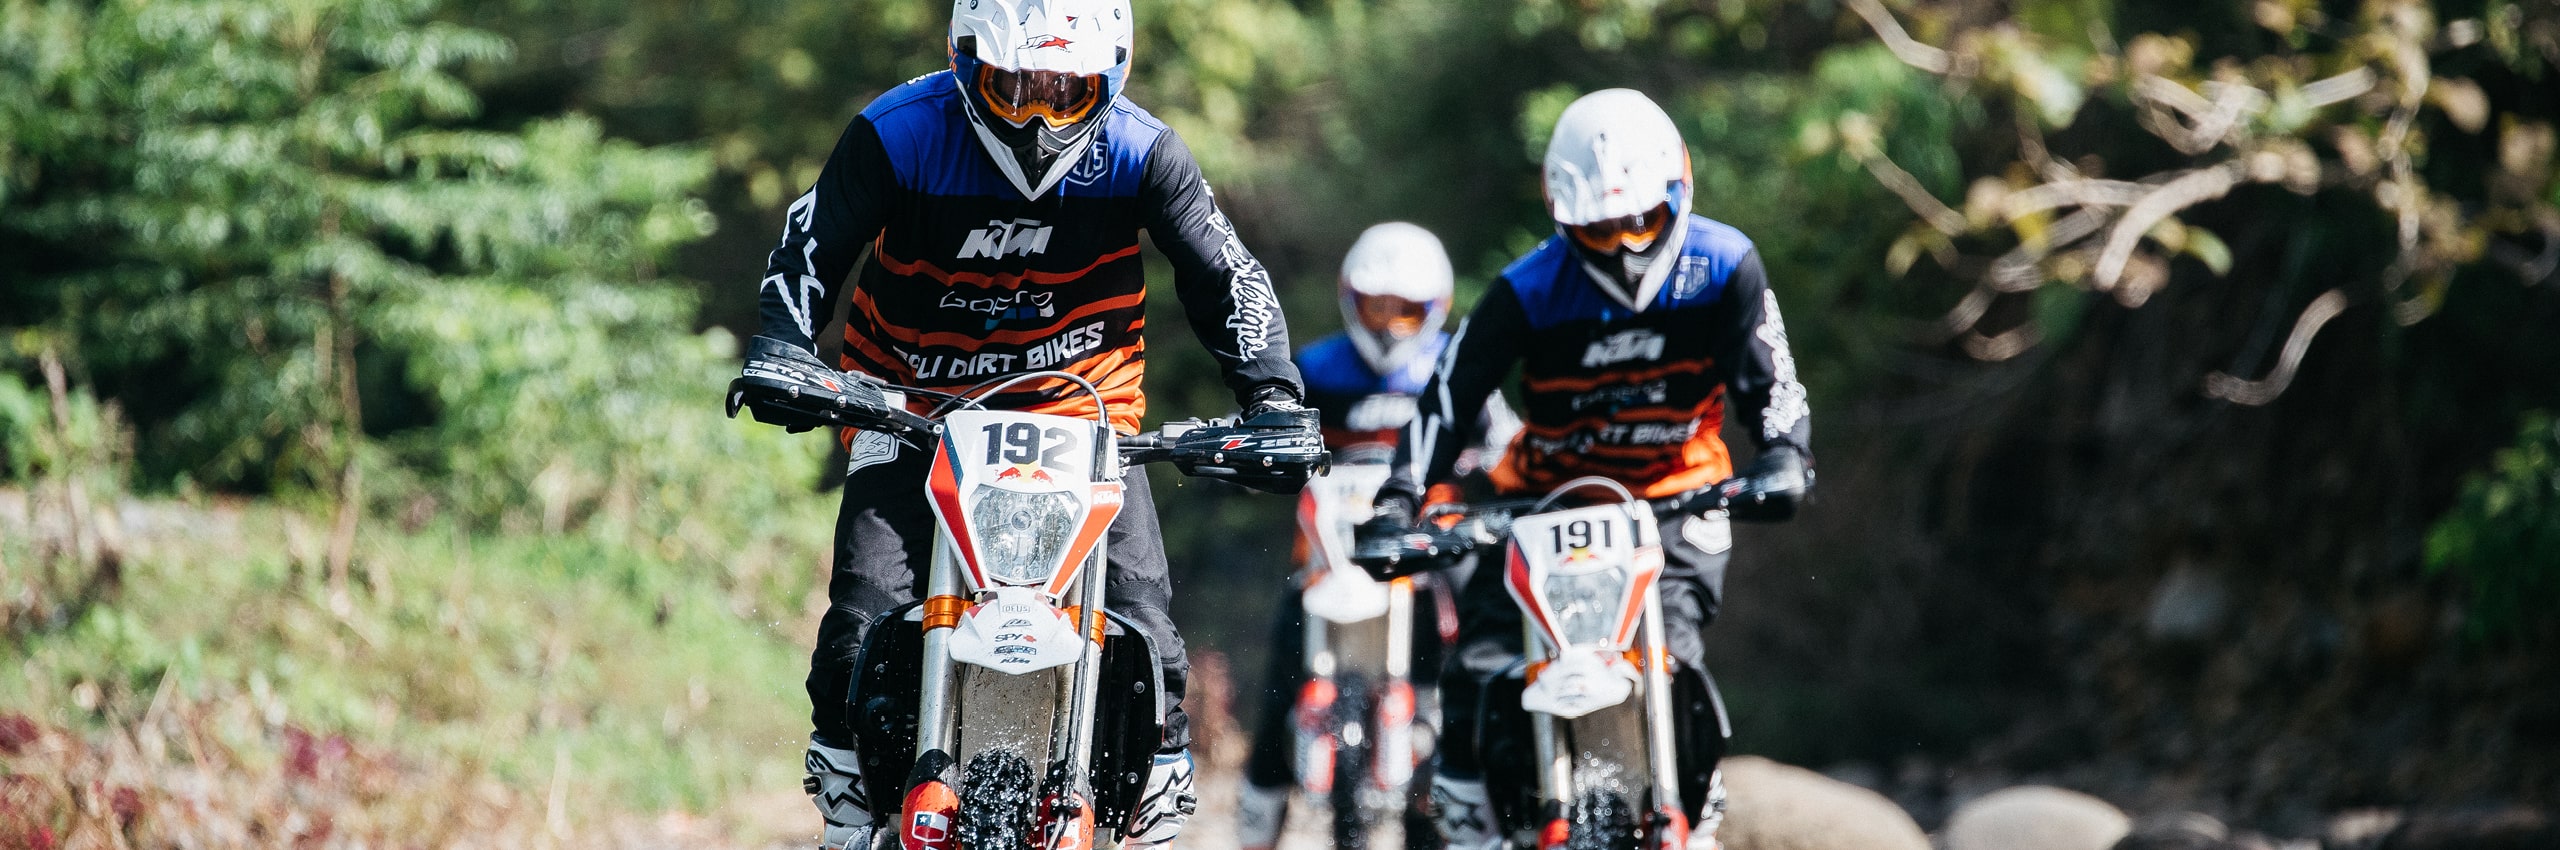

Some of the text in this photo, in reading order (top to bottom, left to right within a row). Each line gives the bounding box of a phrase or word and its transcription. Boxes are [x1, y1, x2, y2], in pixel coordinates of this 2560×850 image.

[957, 218, 1053, 260] KTM
[947, 353, 1018, 379] DIRT
[1026, 320, 1106, 370] BIKES
[748, 359, 807, 382] ZETA
[982, 422, 1078, 475] 192
[1260, 436, 1319, 449] ZETA
[1550, 519, 1612, 554] 191
[994, 633, 1023, 643] SPY
